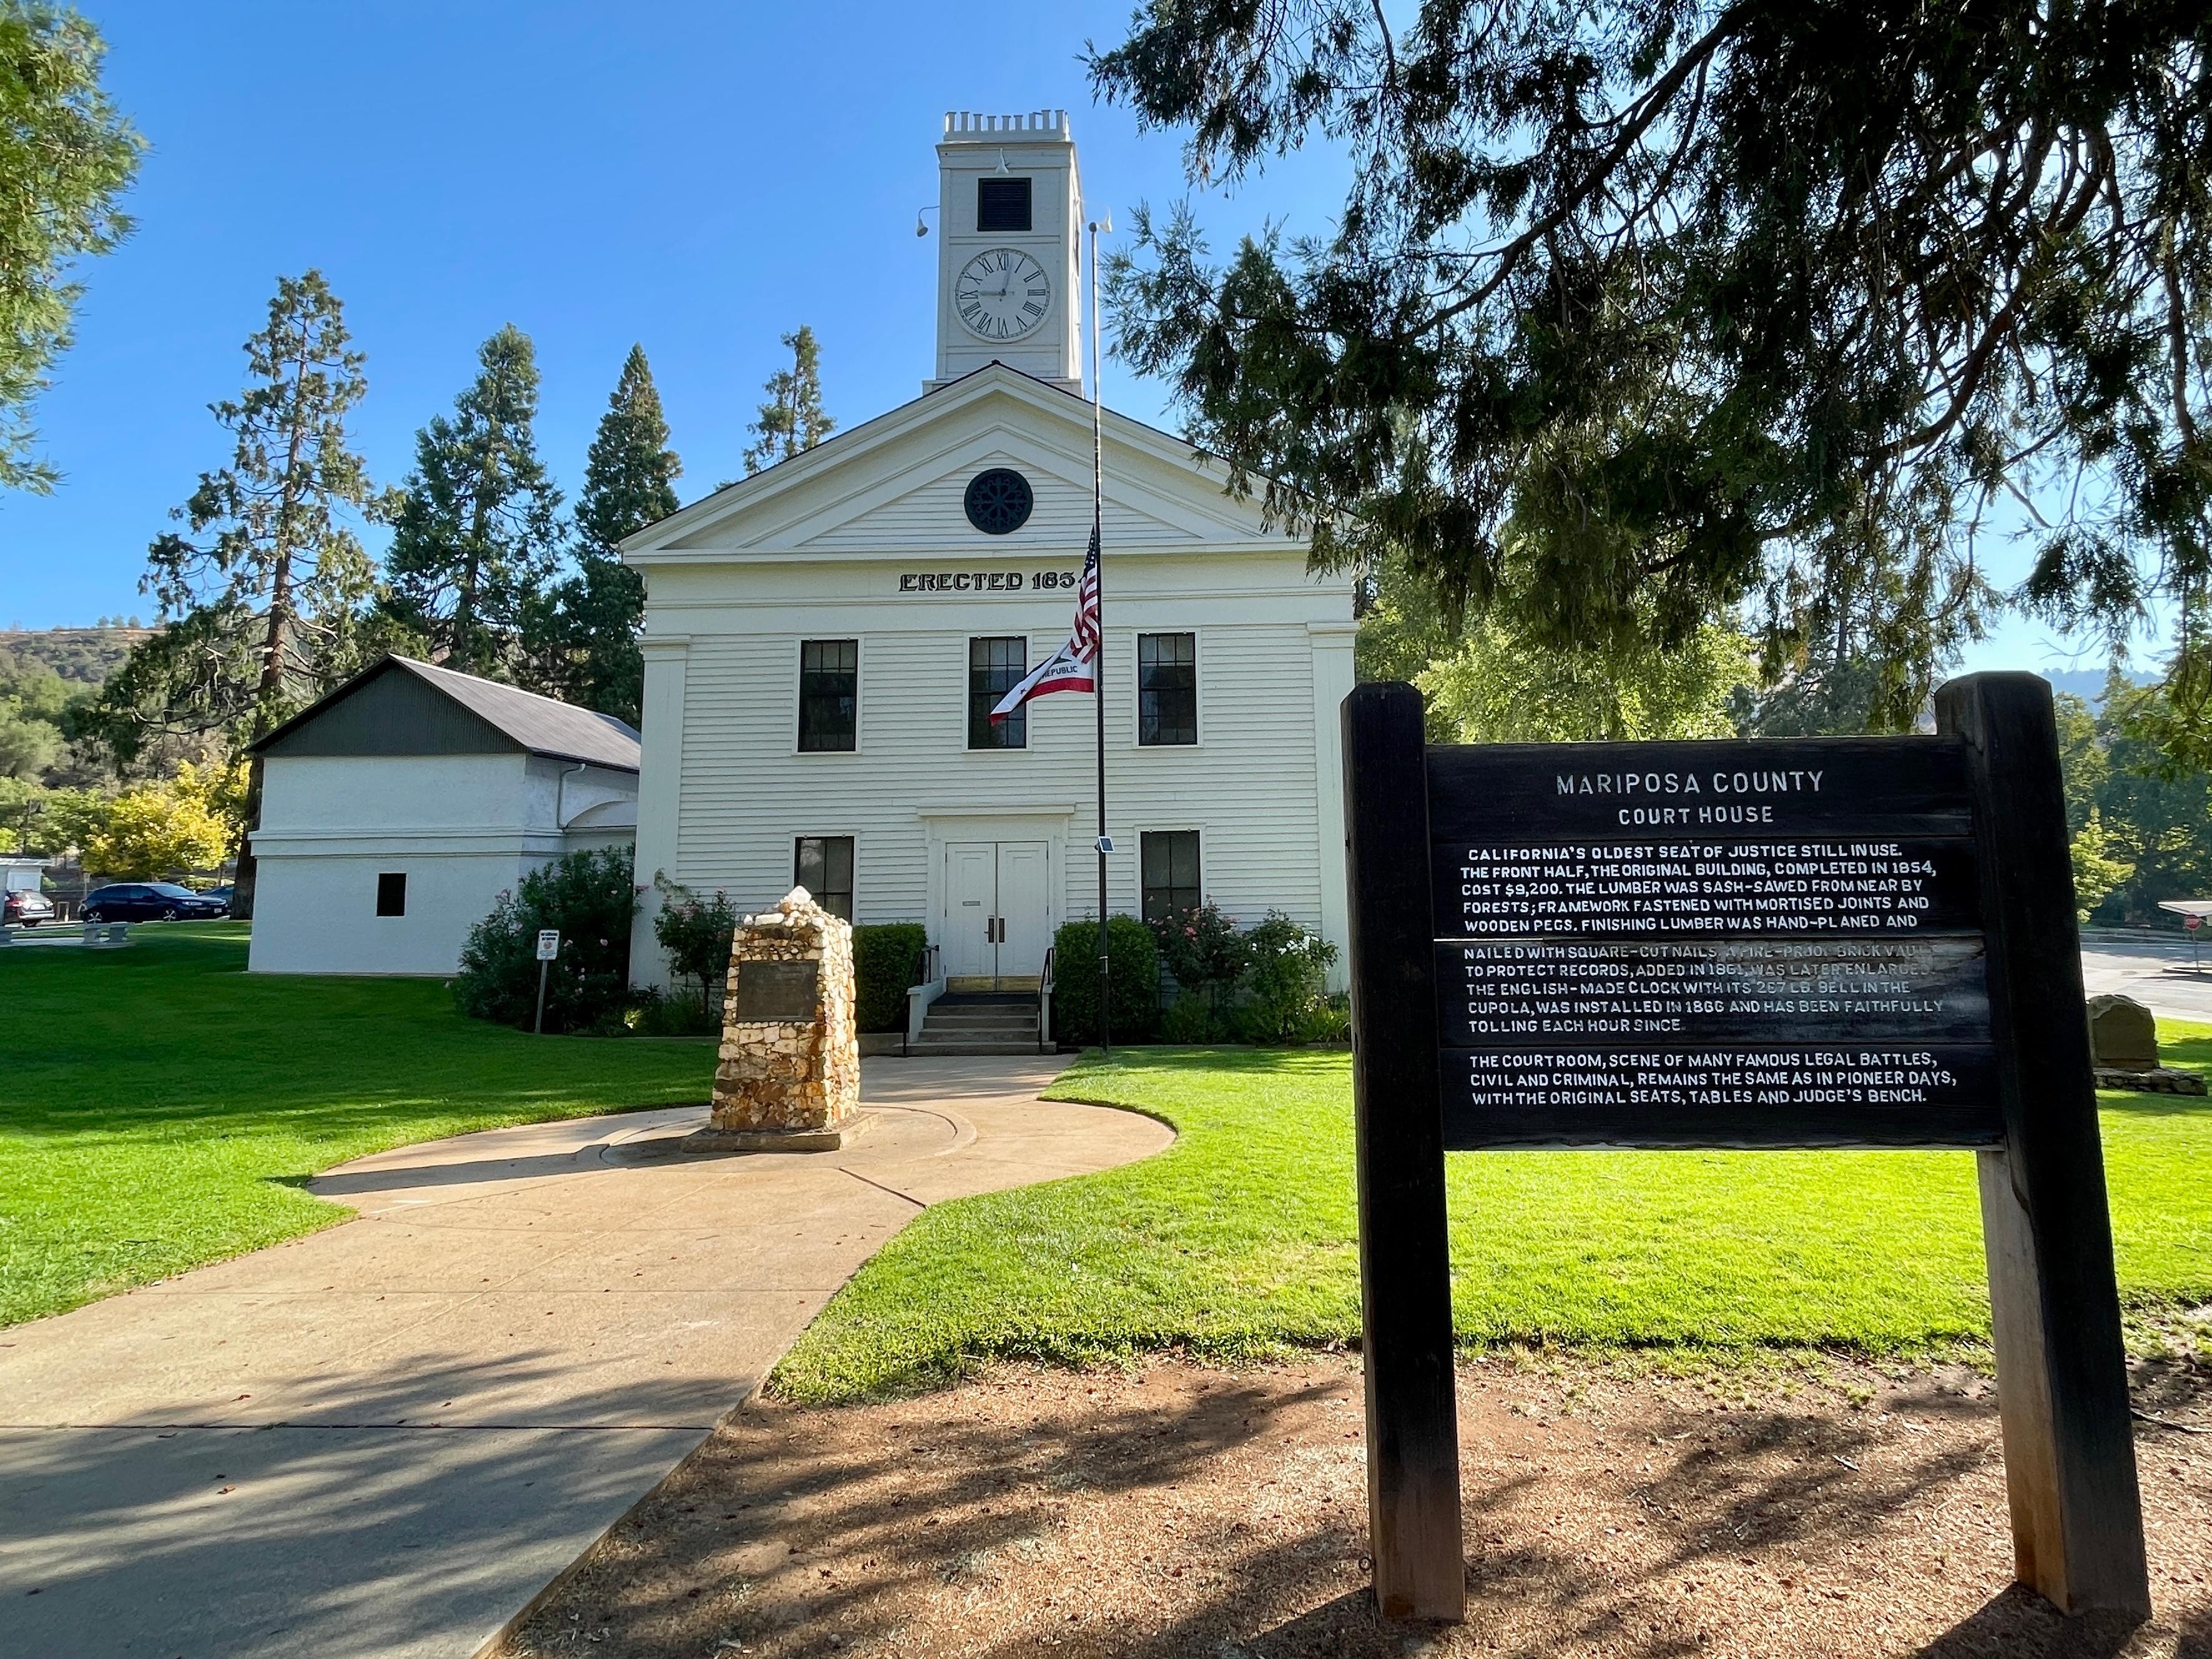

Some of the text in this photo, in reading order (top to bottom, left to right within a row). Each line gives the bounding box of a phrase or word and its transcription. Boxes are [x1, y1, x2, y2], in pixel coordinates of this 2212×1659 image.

[899, 571, 1082, 591] ERECTED 185
[1557, 771, 1822, 794] MARIPOSA COUNTY
[1619, 806, 1773, 824] COURT HOUSE
[1469, 844, 1902, 860] CALIFORNIA'S OLDEST SEAT OF JUSTICE STILL IN USE.
[1460, 860, 1936, 879] THE FRONT HALF, THE ORIGINAL BUILDING, COMPLETED IN 1854,
[1462, 884, 1501, 895] COST
[1505, 883, 1563, 897] $9,200.
[1566, 882, 1595, 894] THE
[1599, 881, 1661, 893] LUMBER
[1664, 881, 1698, 893] WAS
[1703, 880, 1807, 893] SASH-SAWED
[1812, 880, 1854, 892] FROM
[1464, 897, 1929, 916] FORESTS; FRAMEWORK FASTENED WITH MORTISED JOINTS AND
[1465, 915, 1917, 932] WOODEN PEGS. FINISHING LUMBER WAS HAND-PLANED AND
[1465, 947, 1523, 959] NAILED
[1526, 947, 1565, 958] WITH
[1568, 946, 1668, 958] SQUARE-CUT
[1837, 945, 1882, 957] BRICK
[1465, 966, 1483, 977] TO
[1487, 965, 1555, 977] PROTECT
[1560, 964, 1633, 978] RECORDS,
[1636, 964, 1685, 976] ADDED
[1691, 964, 1704, 975] IN
[1751, 964, 1785, 977] WAS
[1791, 964, 1841, 976] LATER
[1467, 984, 1495, 995] THE
[1501, 982, 1625, 995] ENGLISH-MADE
[1628, 981, 1680, 993] CLOCK
[1683, 982, 1723, 993] WITH
[1727, 982, 1751, 993] ITS
[1757, 981, 1786, 993] 267
[1819, 982, 1859, 994] BELL
[1863, 982, 1877, 993] IN
[1880, 981, 1910, 993] THE
[1468, 1000, 1944, 1017] CUPOLA, WAS INSTALLED IN 1866 AND HAS BEEN FAITHFULLY
[1469, 1020, 1537, 1032] TOLLING
[1543, 1020, 1583, 1031] EACH
[1588, 1019, 1630, 1031] HOUR
[1470, 1056, 1498, 1068] THE
[1610, 1055, 1660, 1067] SCENE
[1664, 1055, 1683, 1066] OF
[1688, 1053, 1732, 1066] MANY
[1737, 1053, 1799, 1066] FAMOUS
[1805, 1053, 1856, 1066] LEGAL
[1861, 1052, 1937, 1068] BATTLES,
[1471, 1071, 1956, 1088] CIVIL AND CRIMINAL, REMAINS THE SAME AS IN PIONEER DAYS,
[1472, 1089, 1927, 1105] WITH THE ORIGINAL SEATS, TABLES AND JUDGE'S BENCH.
